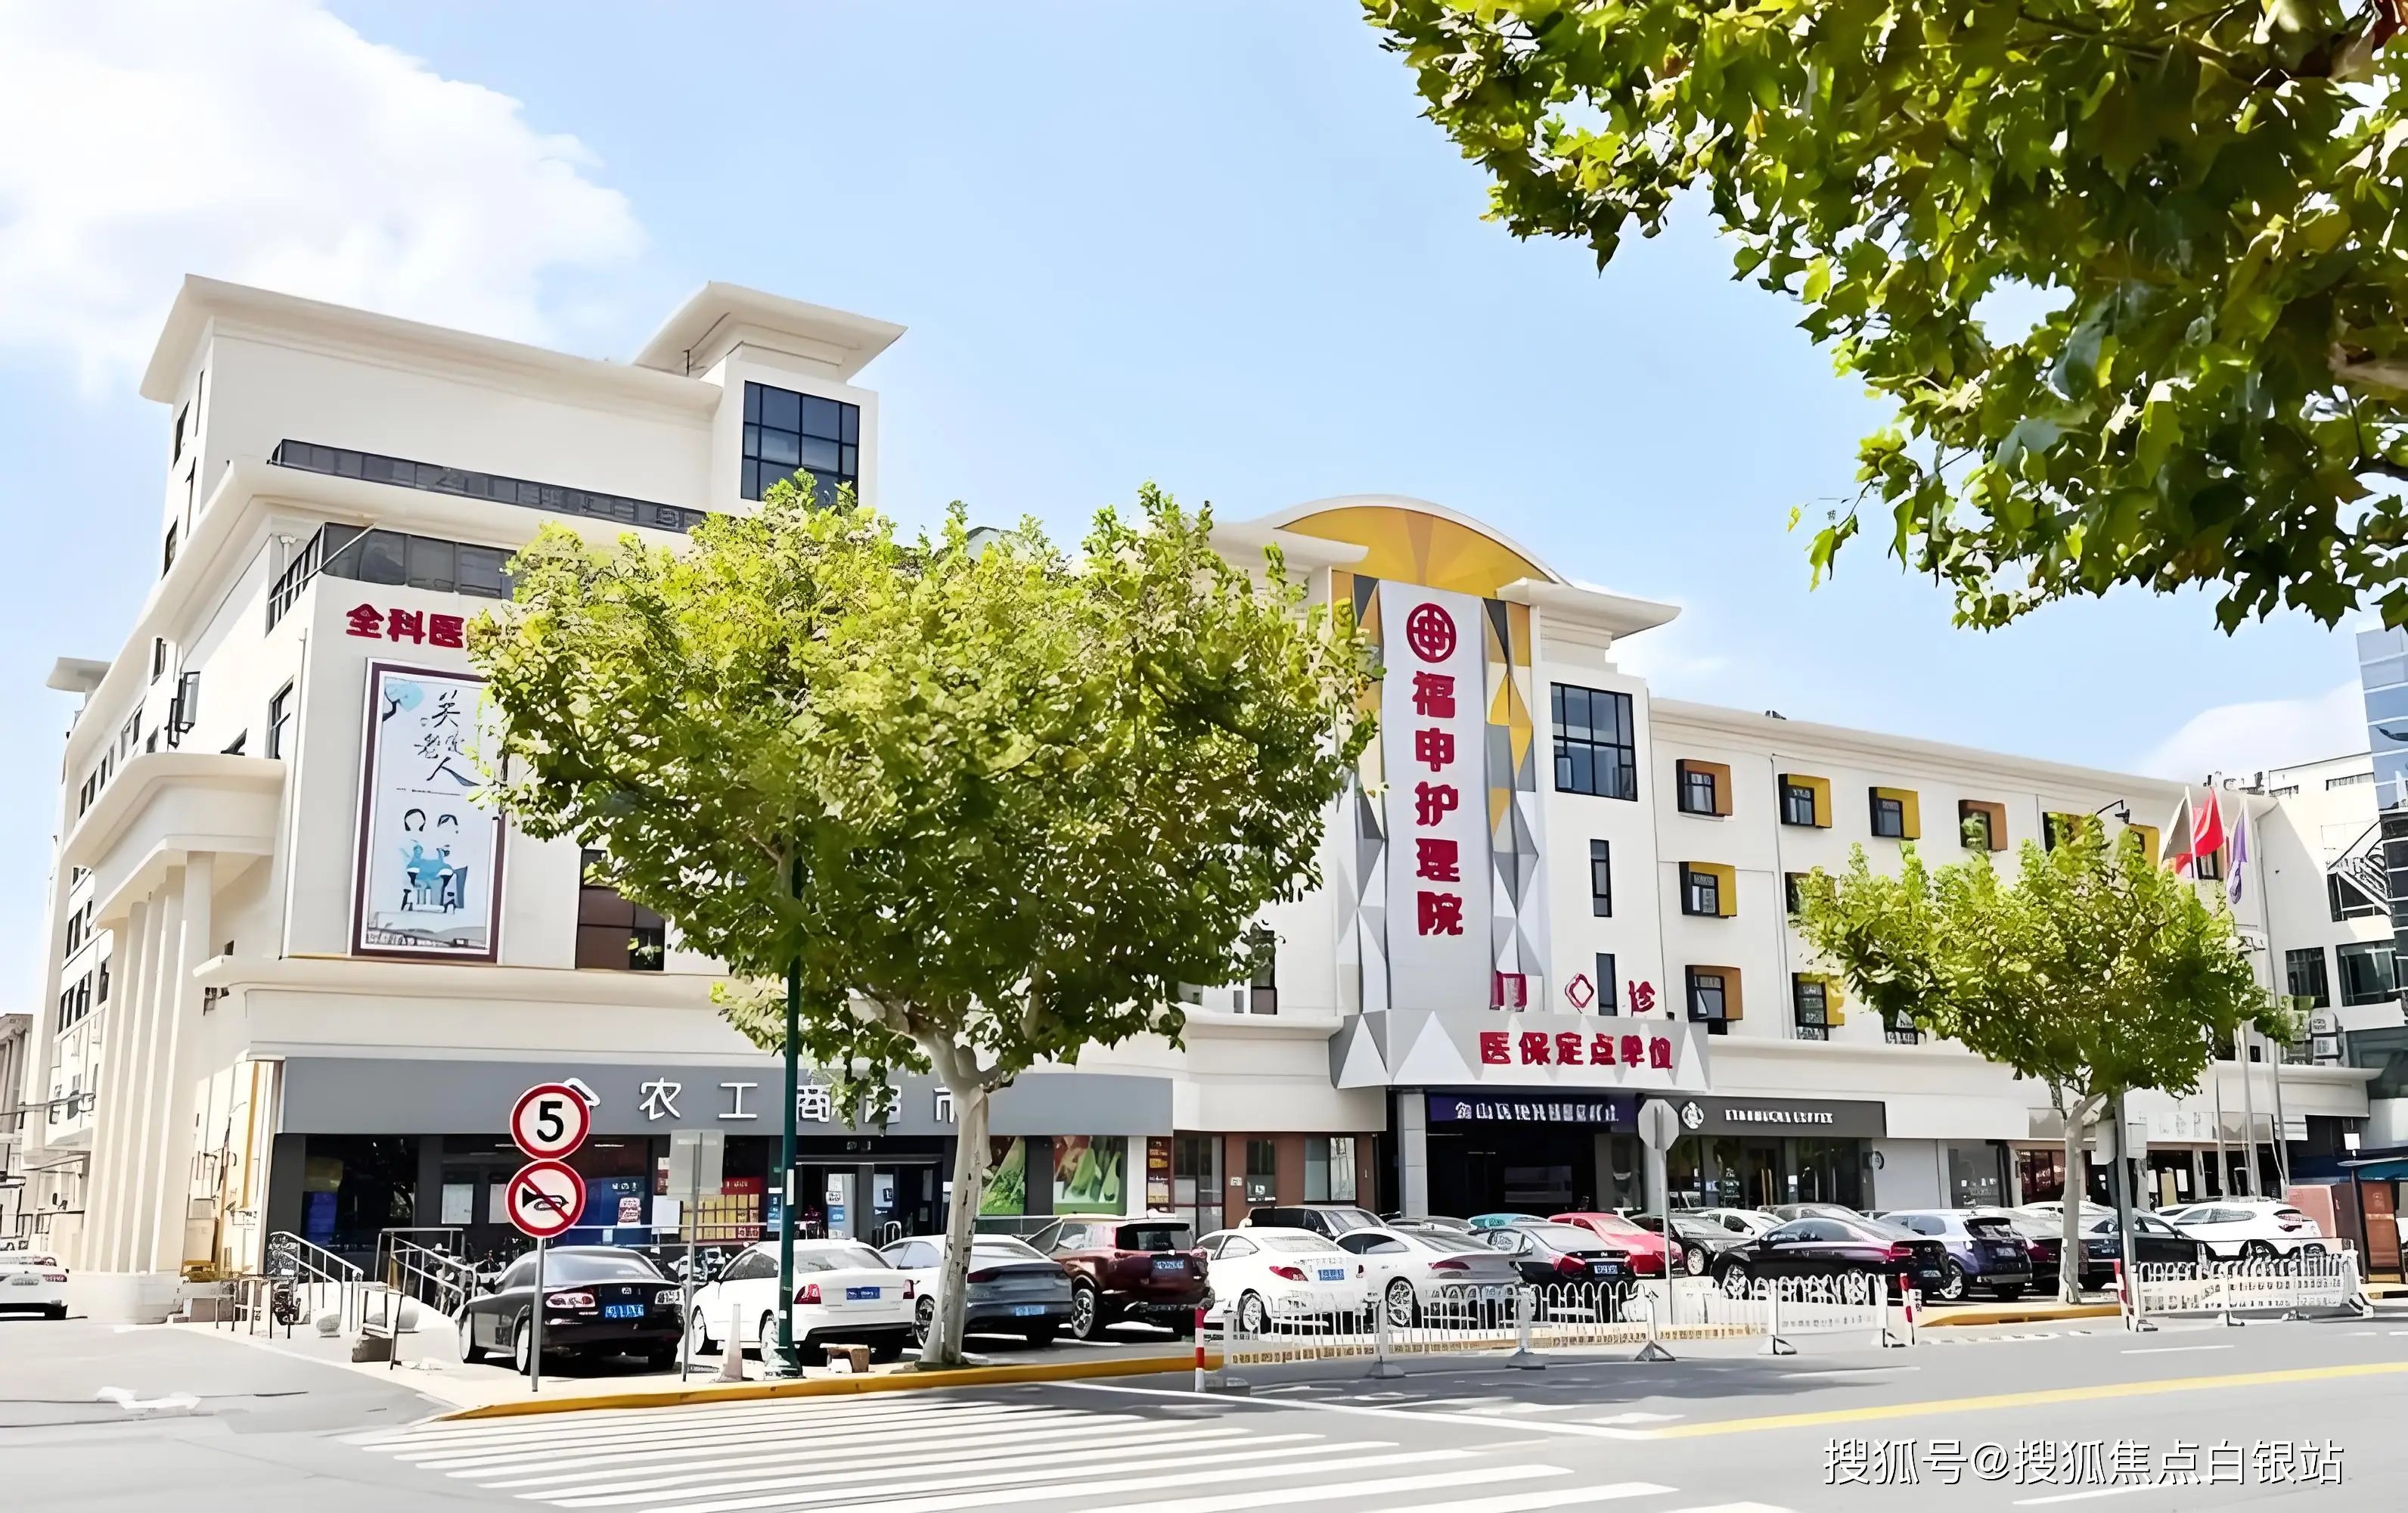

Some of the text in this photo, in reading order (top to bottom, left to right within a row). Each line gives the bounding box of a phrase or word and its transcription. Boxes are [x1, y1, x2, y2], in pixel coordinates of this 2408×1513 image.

[346, 604, 470, 649] 全科医
[1412, 670, 1463, 937] 福申护理院
[536, 1101, 564, 1142] 5
